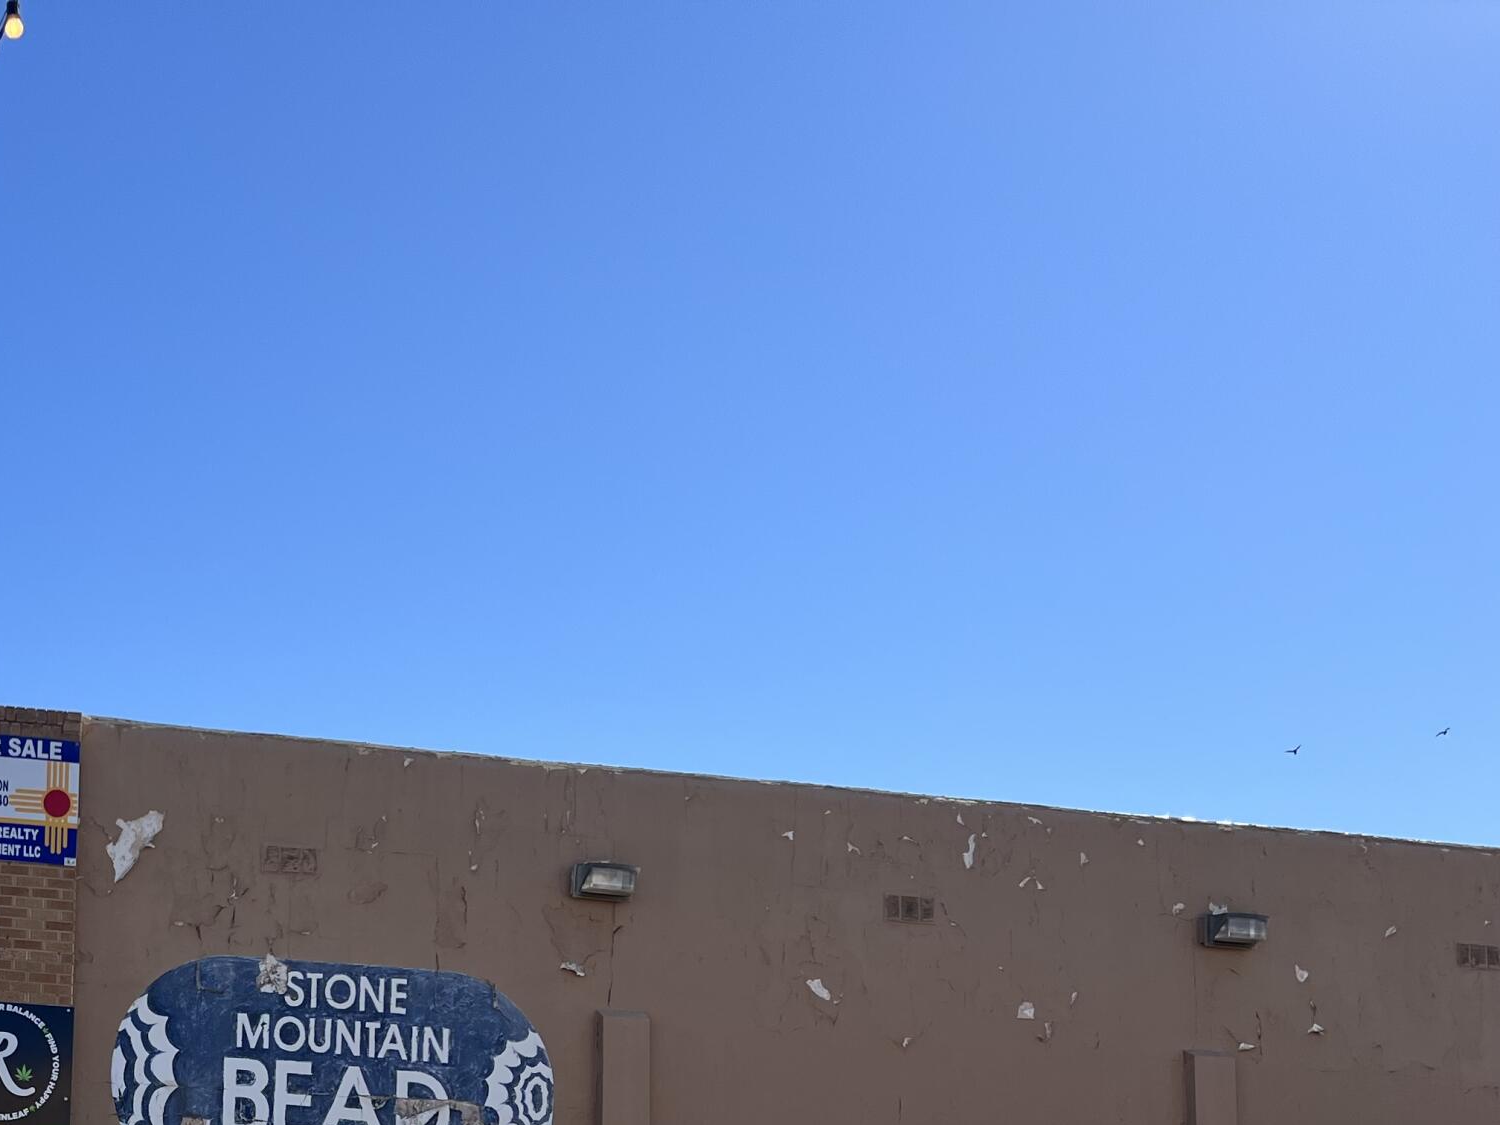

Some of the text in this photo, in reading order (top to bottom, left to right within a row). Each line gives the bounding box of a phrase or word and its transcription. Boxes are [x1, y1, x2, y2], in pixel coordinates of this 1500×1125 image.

[8, 737, 63, 760] SALE
[23, 845, 41, 858] LLC
[284, 971, 408, 1015] STONE
[6, 1003, 46, 1030] BALANCE
[236, 1013, 450, 1064] MOUNTAIN
[34, 1033, 60, 1110] FIND YOUR HAPPY
